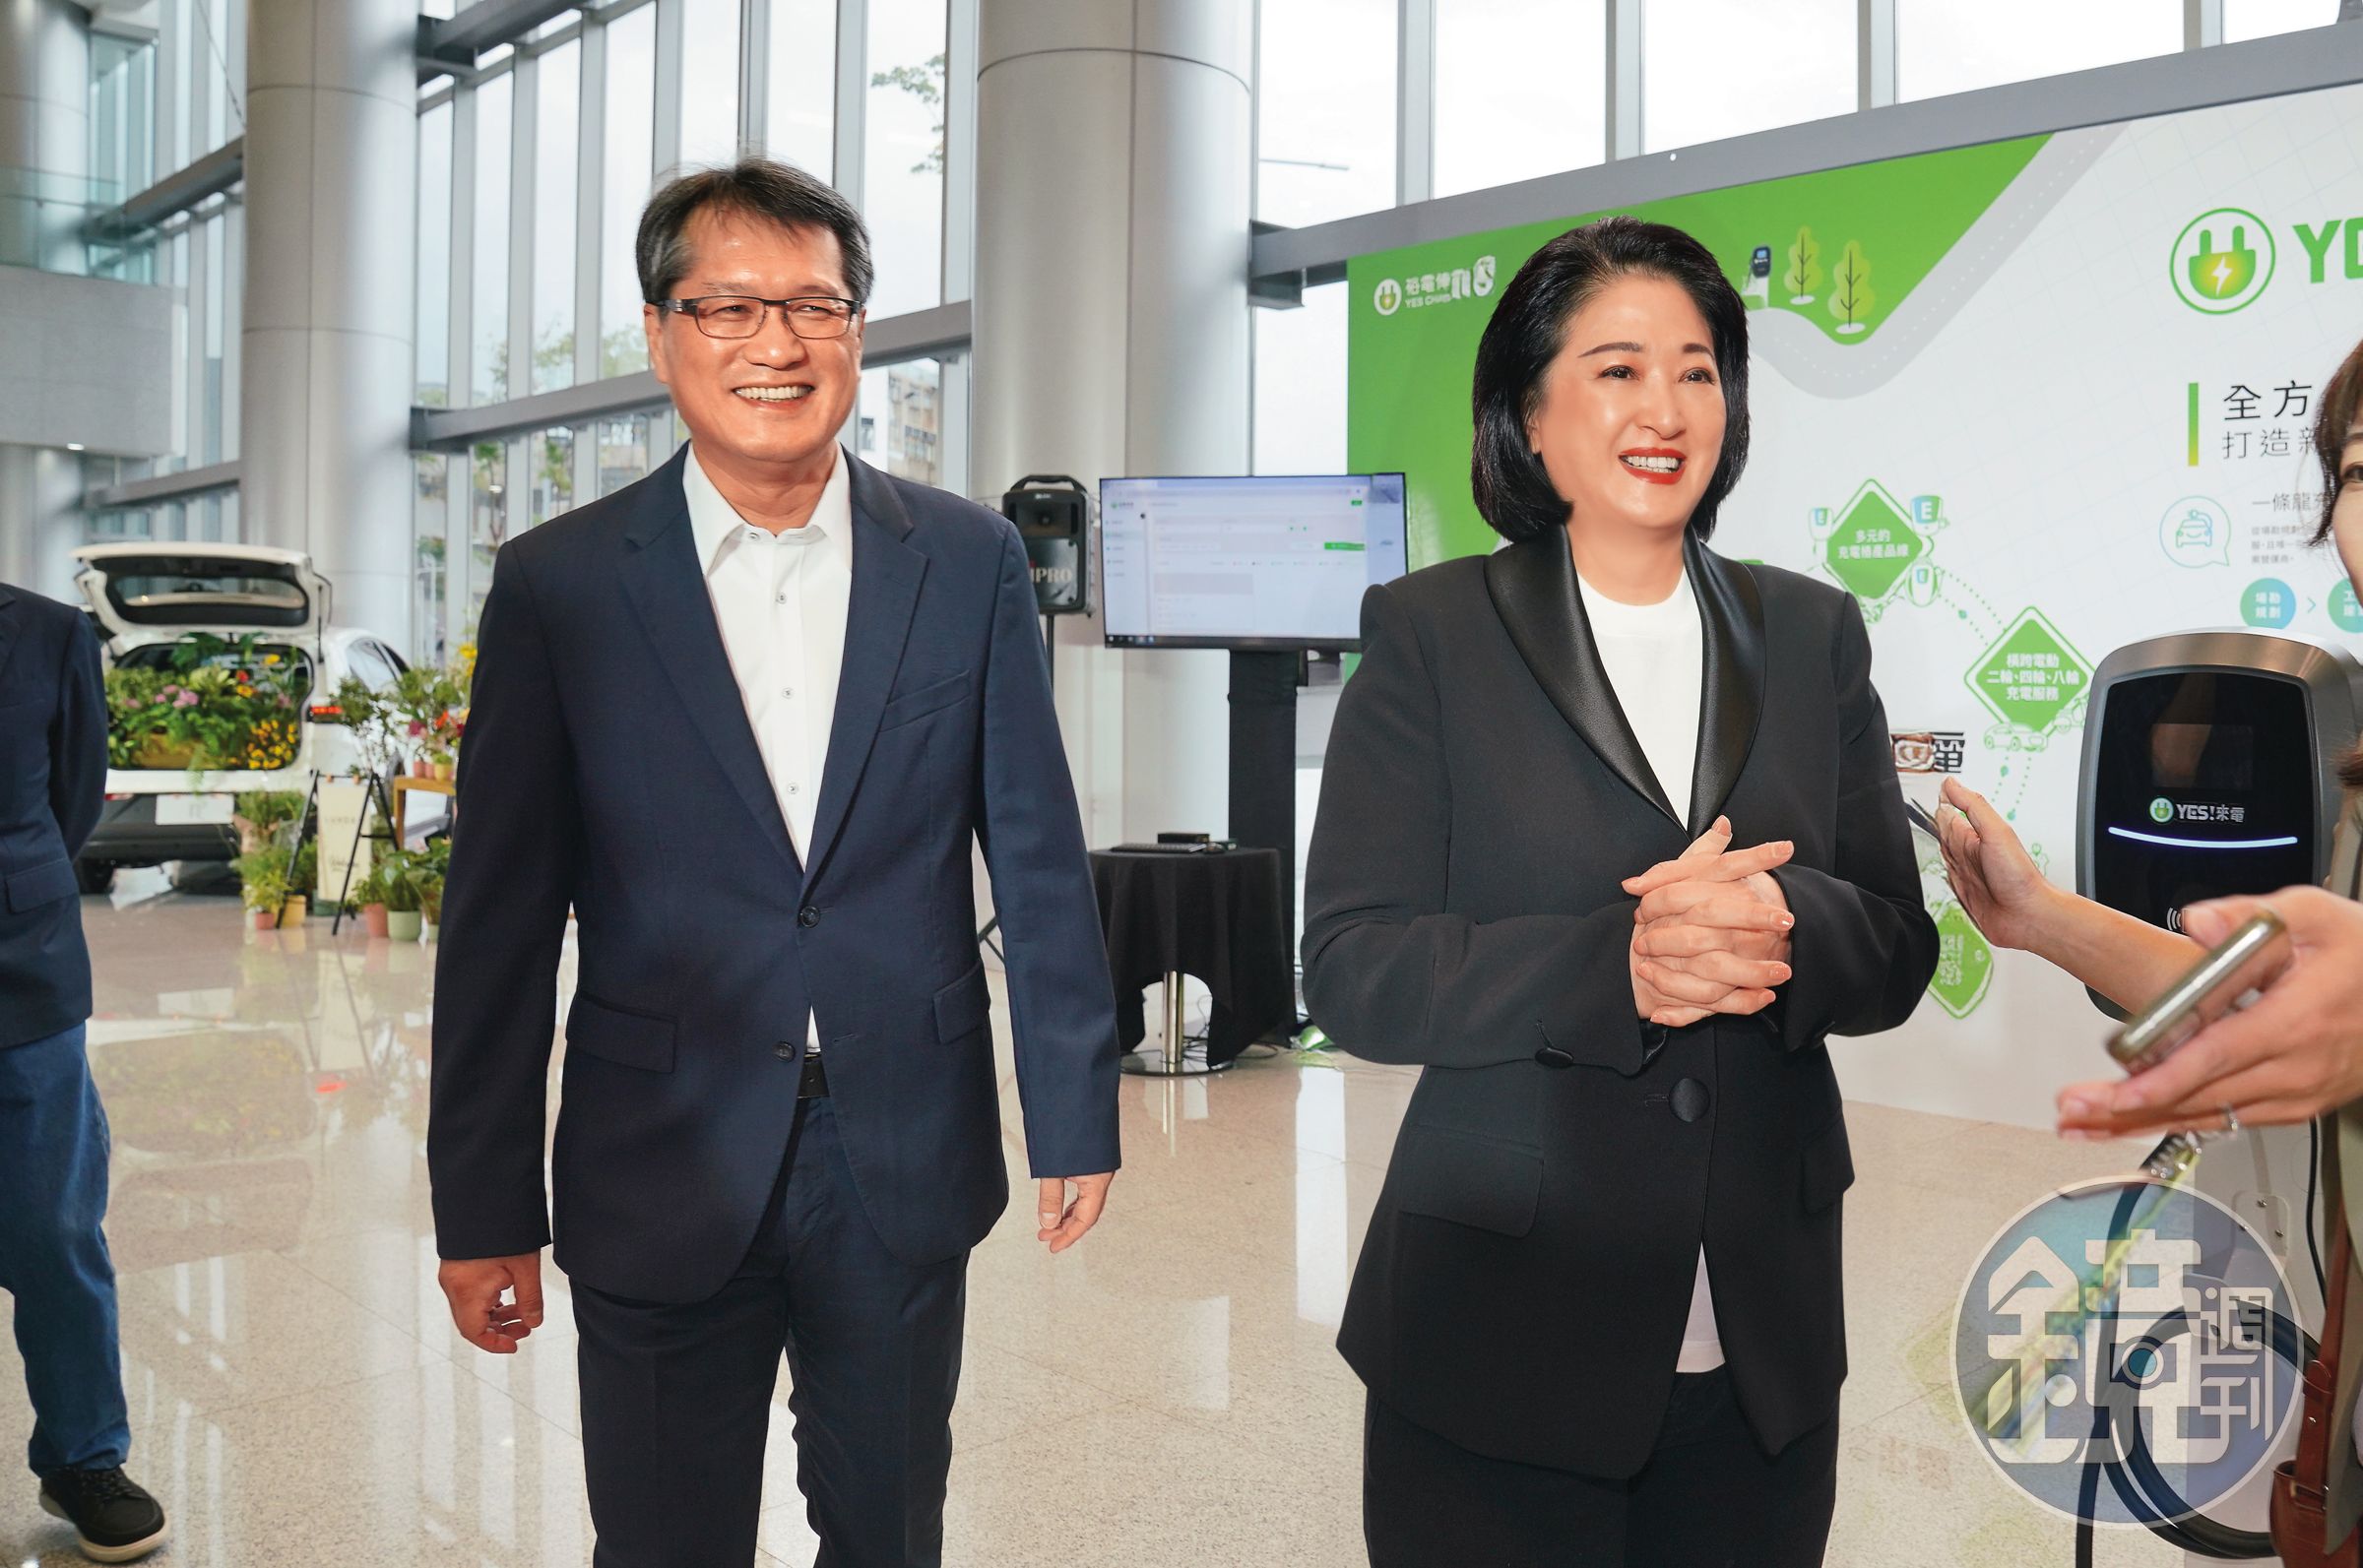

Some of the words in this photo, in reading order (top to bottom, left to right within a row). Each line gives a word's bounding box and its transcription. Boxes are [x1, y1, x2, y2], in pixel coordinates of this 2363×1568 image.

[2223, 380, 2312, 420] 全方
[1855, 529, 1890, 543] 多元的
[1029, 567, 1073, 584] IPRO
[2007, 686, 2059, 702] 充電服務
